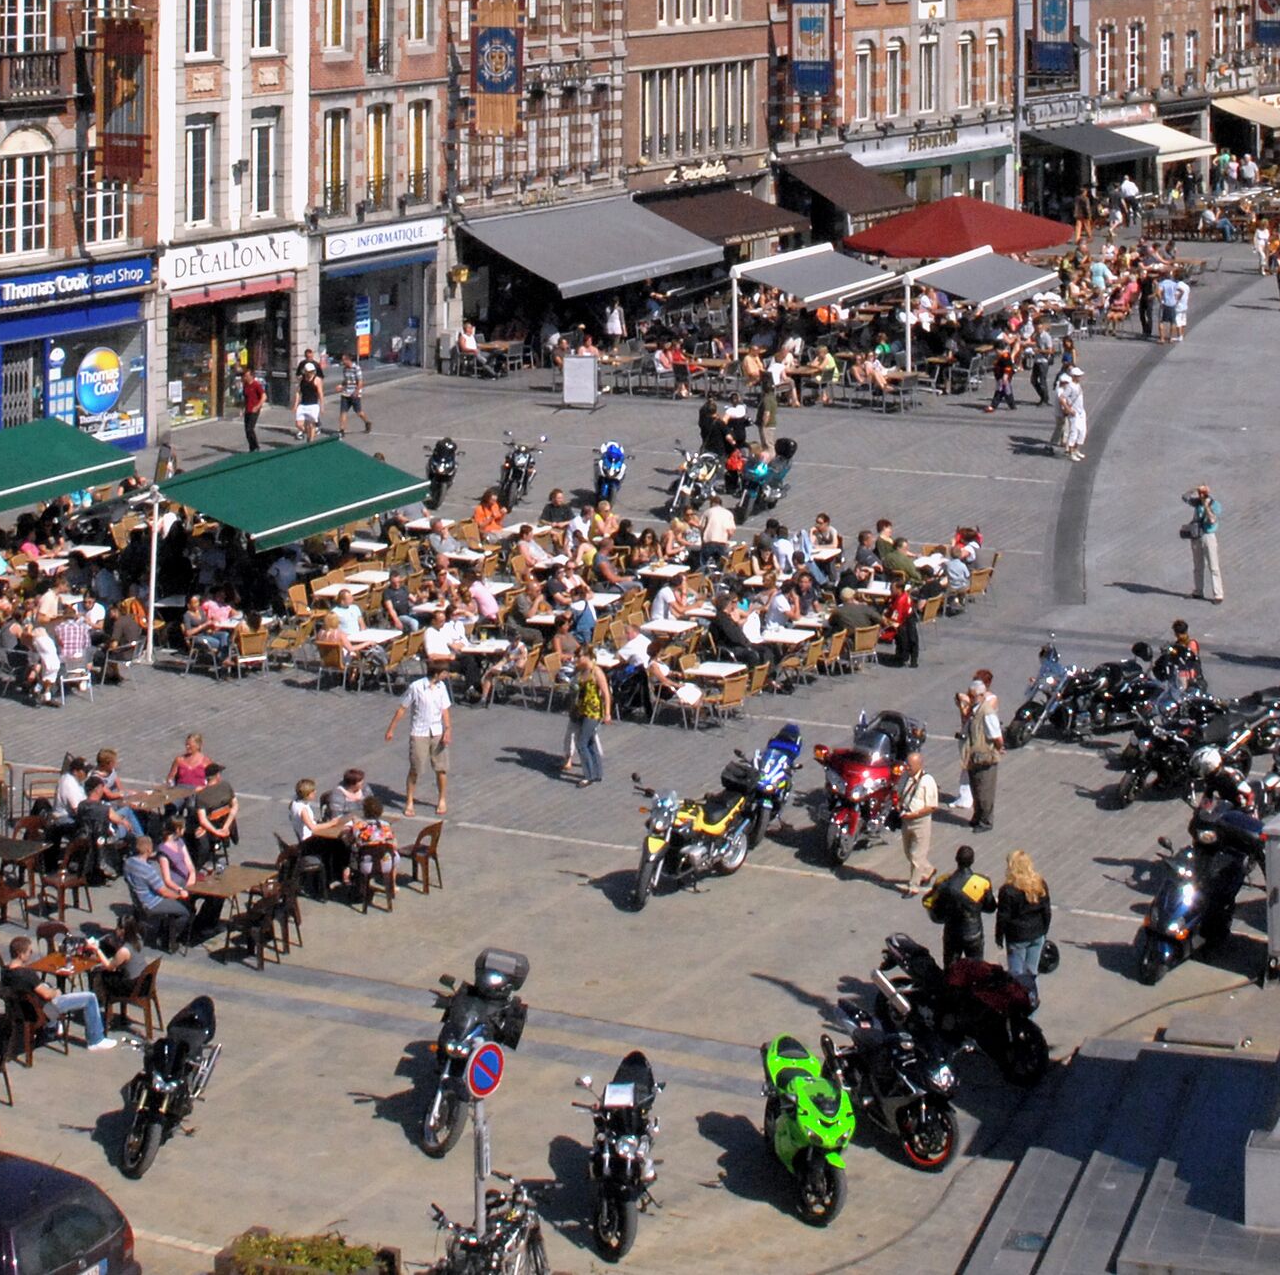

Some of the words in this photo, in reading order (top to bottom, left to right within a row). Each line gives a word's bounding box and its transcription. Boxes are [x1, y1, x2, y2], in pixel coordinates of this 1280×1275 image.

[174, 239, 291, 278] DECALLONNE
[0, 280, 56, 301] Thomas
[54, 273, 91, 292] Cook
[91, 270, 117, 285] ravel
[118, 268, 144, 282] Shop
[79, 368, 119, 385] Thomas
[94, 380, 119, 396] Cook
